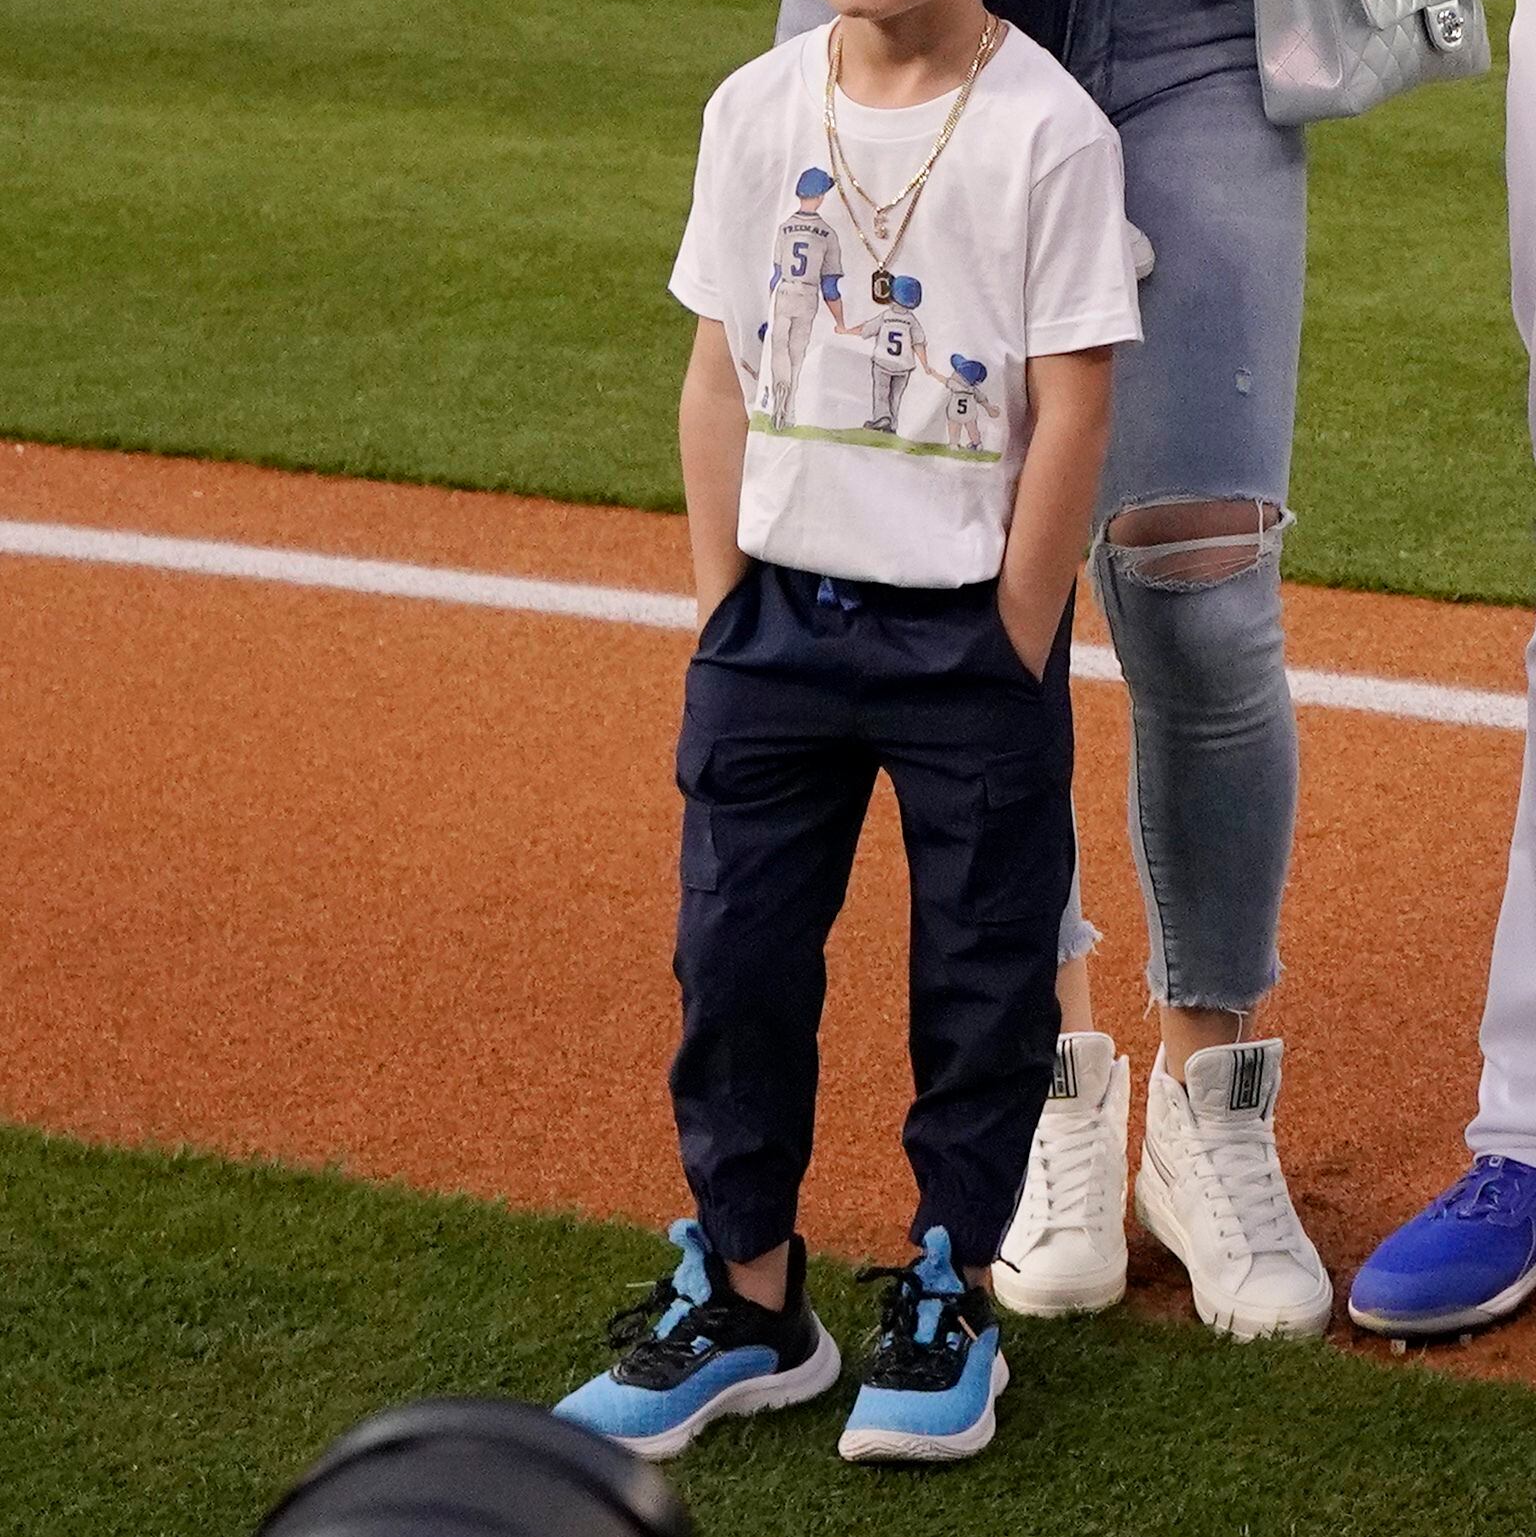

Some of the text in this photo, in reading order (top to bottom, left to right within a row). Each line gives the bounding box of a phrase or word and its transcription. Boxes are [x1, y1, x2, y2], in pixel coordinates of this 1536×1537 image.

[790, 241, 809, 277] 5
[886, 331, 903, 357] 5
[956, 399, 968, 415] 5
